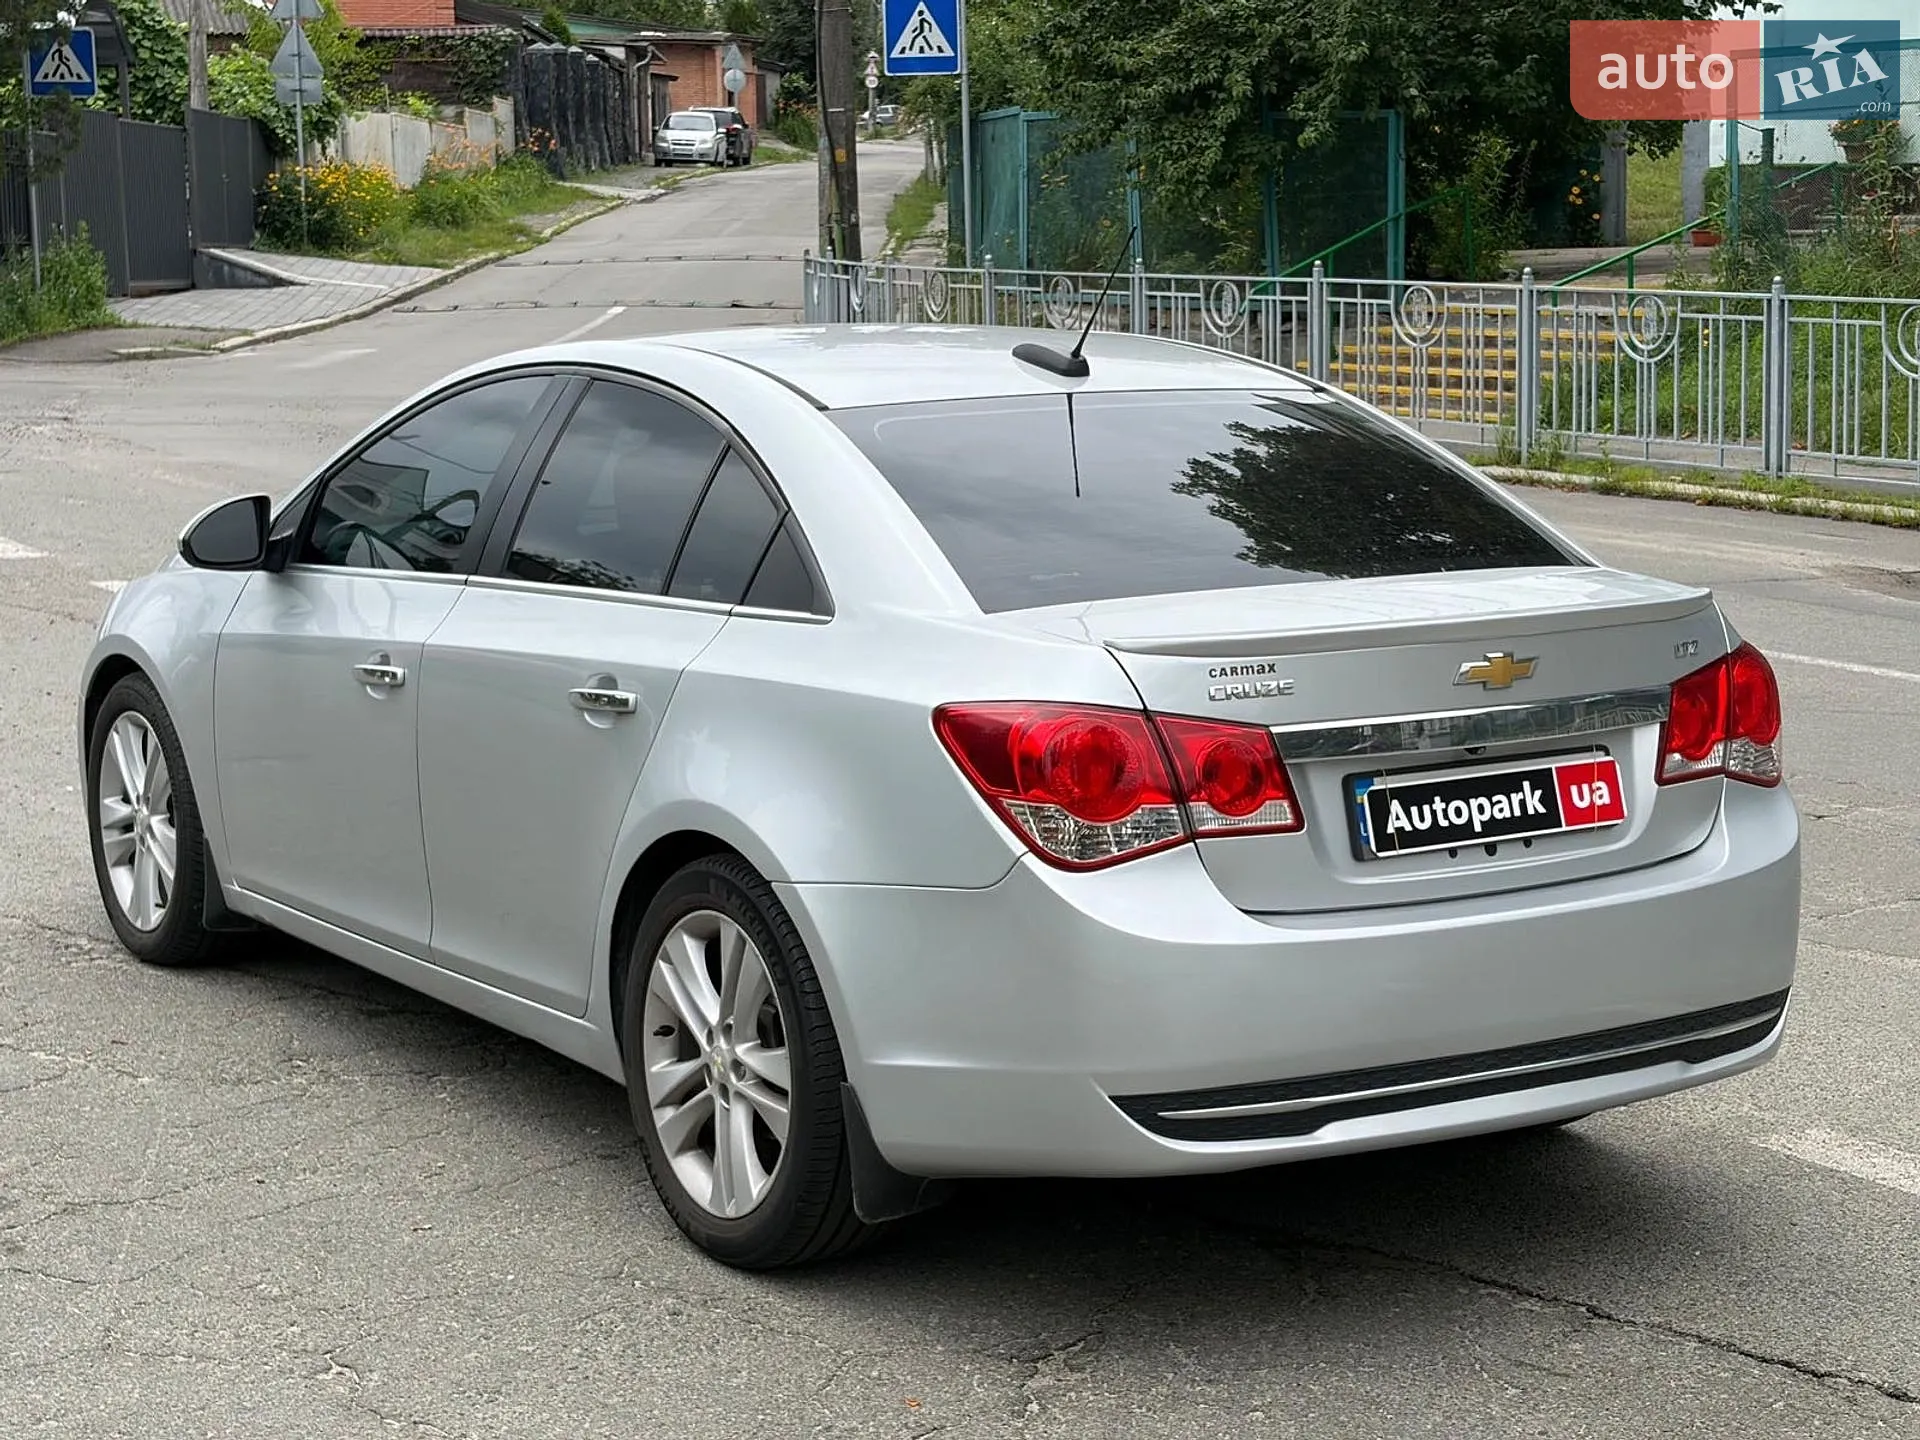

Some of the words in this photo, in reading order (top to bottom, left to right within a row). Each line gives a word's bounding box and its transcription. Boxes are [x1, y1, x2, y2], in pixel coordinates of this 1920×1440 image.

[1208, 678, 1295, 702] CRUZE
[1386, 780, 1546, 834] Autopark
[1570, 779, 1611, 809] ua
